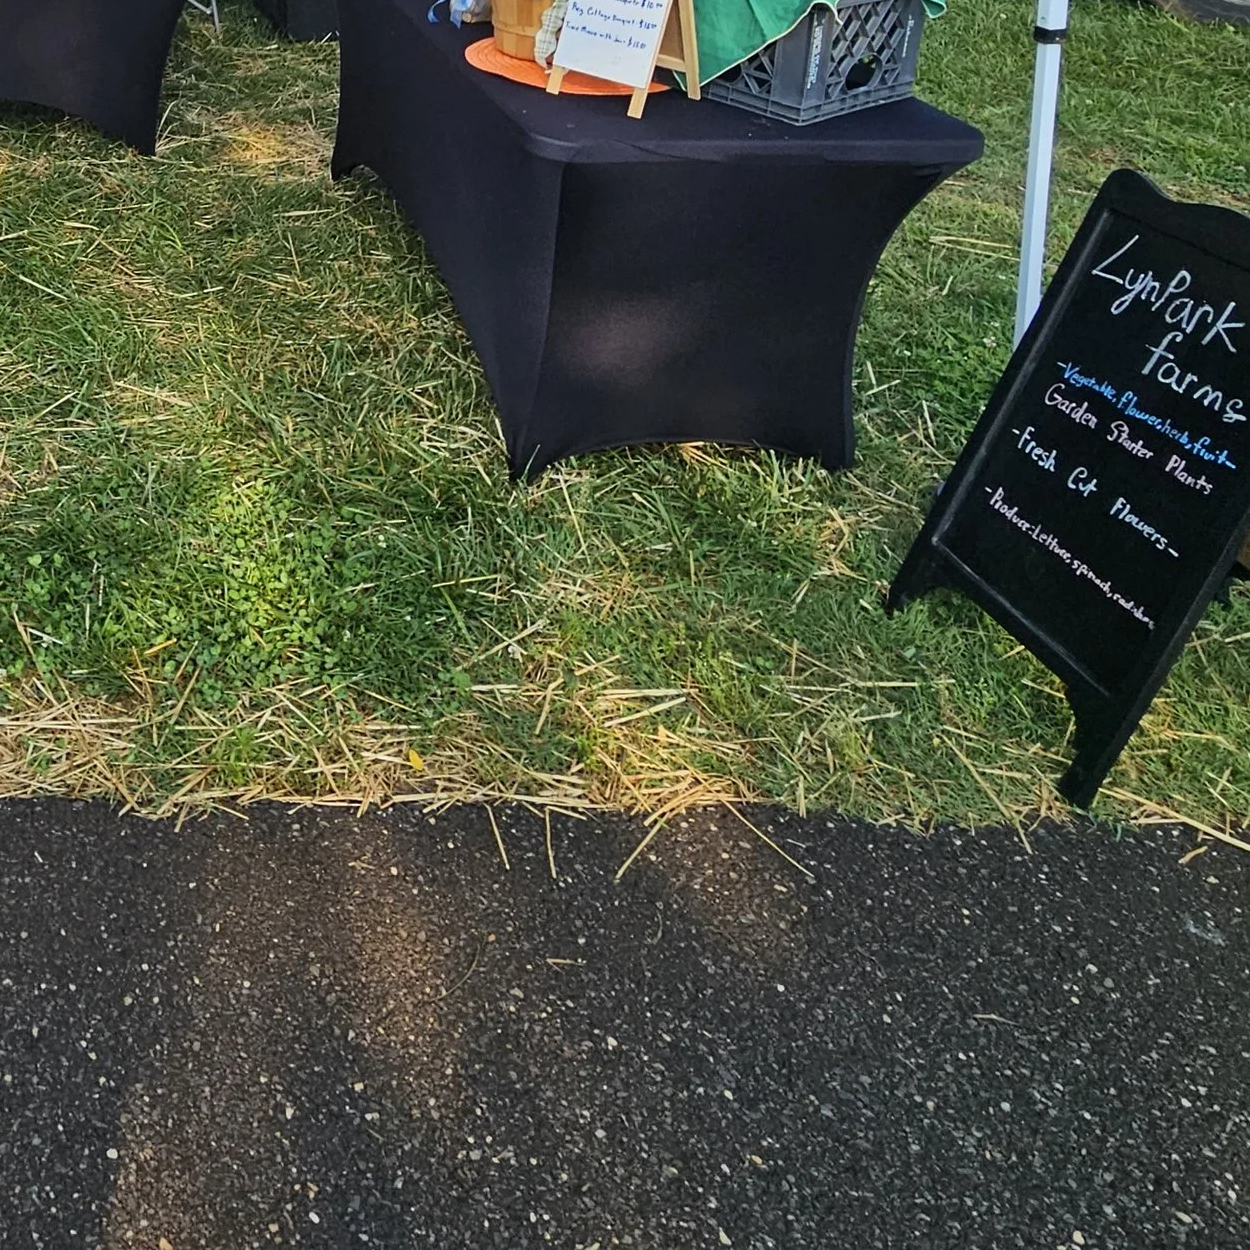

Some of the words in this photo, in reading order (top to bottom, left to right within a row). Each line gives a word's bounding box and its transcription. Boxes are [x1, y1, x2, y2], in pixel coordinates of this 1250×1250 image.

[1091, 234, 1246, 353] LynPark
[1044, 382, 1098, 429] Garden
[1106, 420, 1154, 459] Starter
[1164, 454, 1214, 495] Plants
[1067, 467, 1098, 497] Cut
